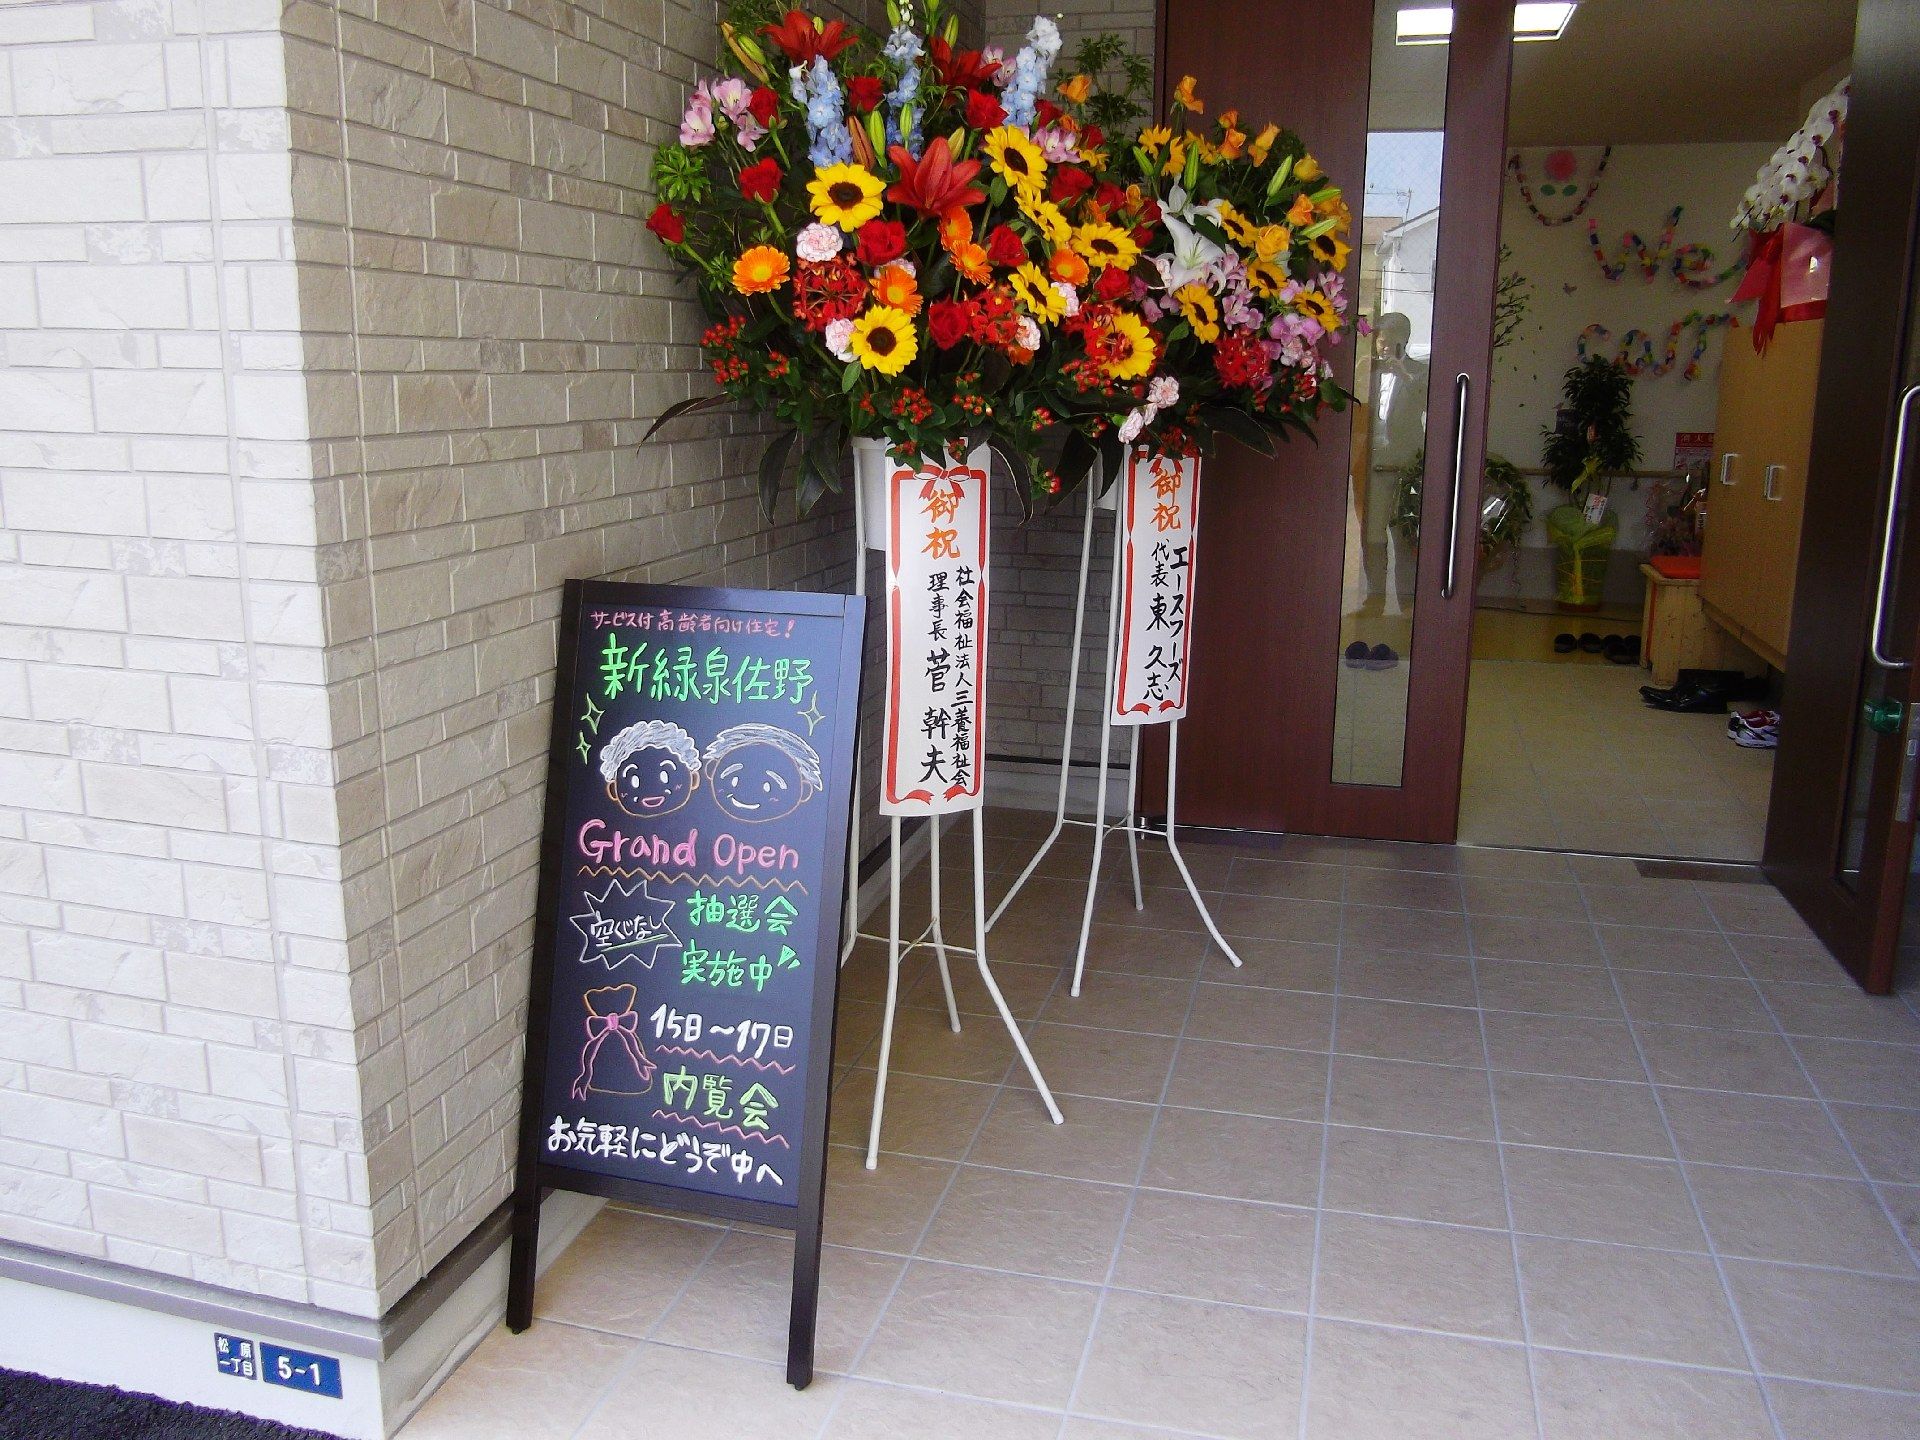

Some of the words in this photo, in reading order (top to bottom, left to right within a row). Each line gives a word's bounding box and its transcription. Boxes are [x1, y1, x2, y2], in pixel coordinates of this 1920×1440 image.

[921, 490, 960, 560] 御祝
[1150, 470, 1182, 532] 御祝
[1167, 547, 1190, 683] エースフーズ
[599, 632, 815, 705] 新緑泉佐野
[578, 818, 699, 868] Grand
[714, 833, 800, 875] Open
[685, 889, 800, 936] 抽選会
[662, 1065, 779, 1131] 内覧会
[546, 1115, 784, 1186] お気軽にどうぞ中へ
[217, 1336, 252, 1358] 松原
[218, 1357, 254, 1377] 一丁目
[277, 1355, 321, 1387] 5-1
